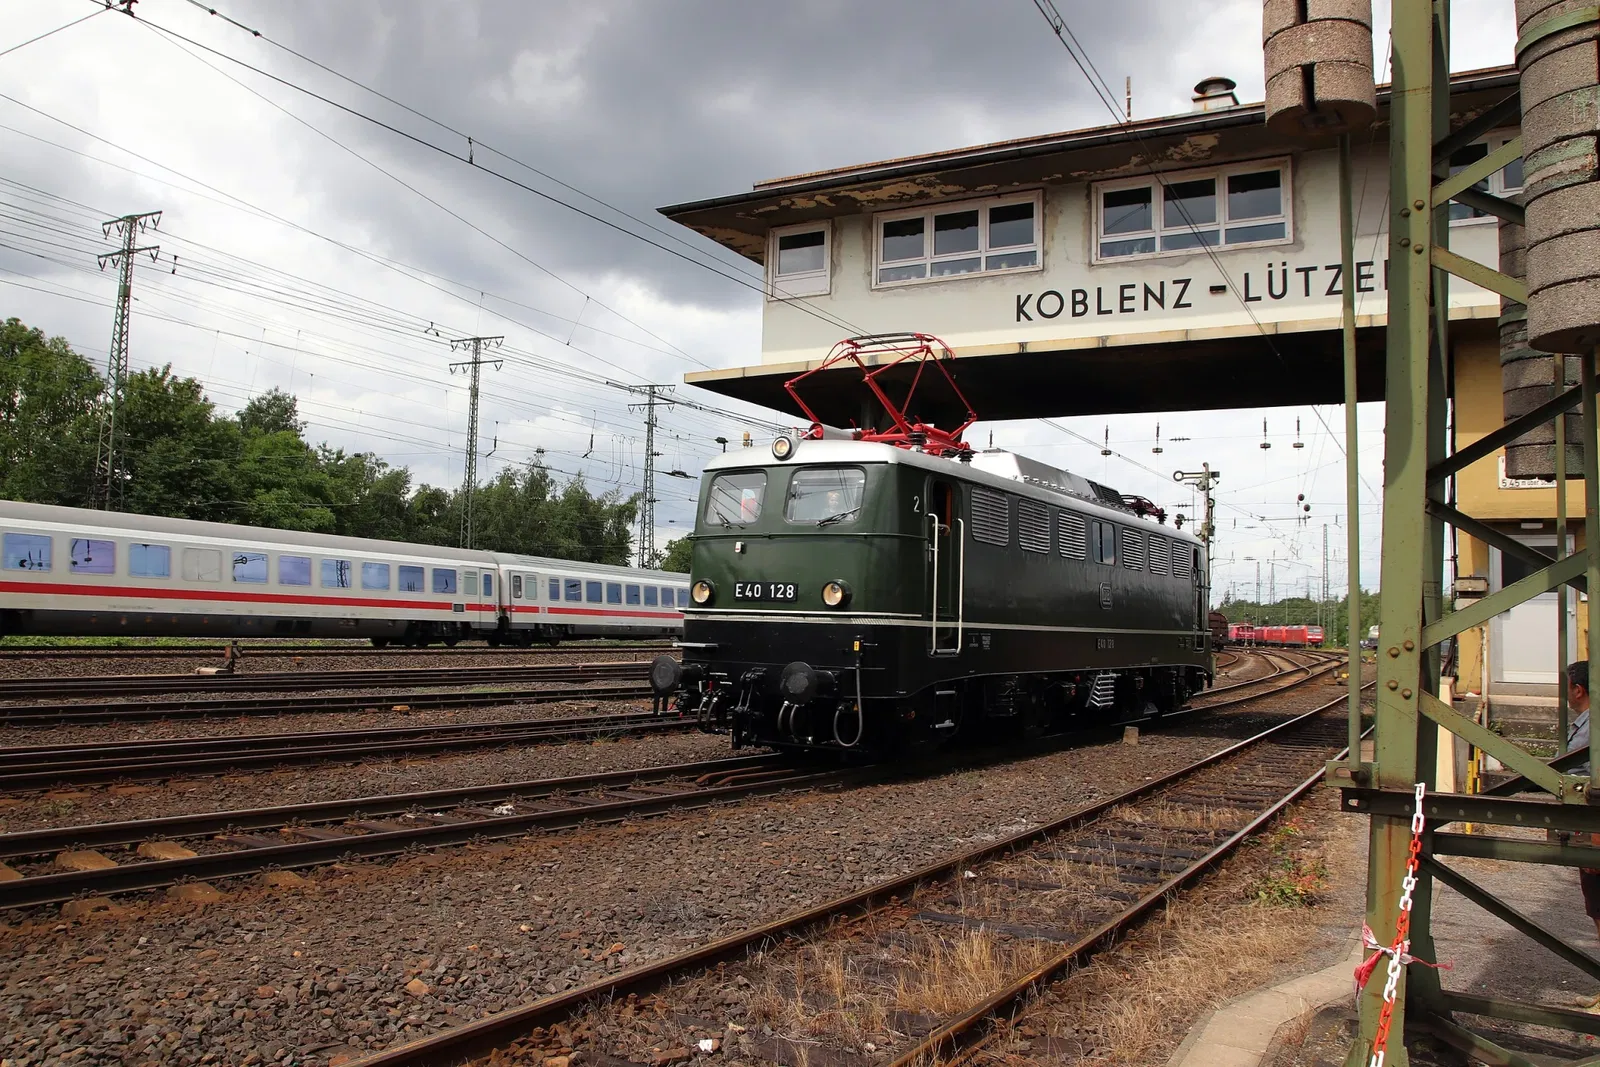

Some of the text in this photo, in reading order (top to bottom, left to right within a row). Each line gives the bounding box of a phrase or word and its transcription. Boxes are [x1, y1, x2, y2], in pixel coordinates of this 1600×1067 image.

[1016, 278, 1192, 322] KOBLENZ
[1244, 260, 1389, 302] LÜTZE
[913, 495, 920, 513] 2
[735, 583, 795, 598] E40 128
